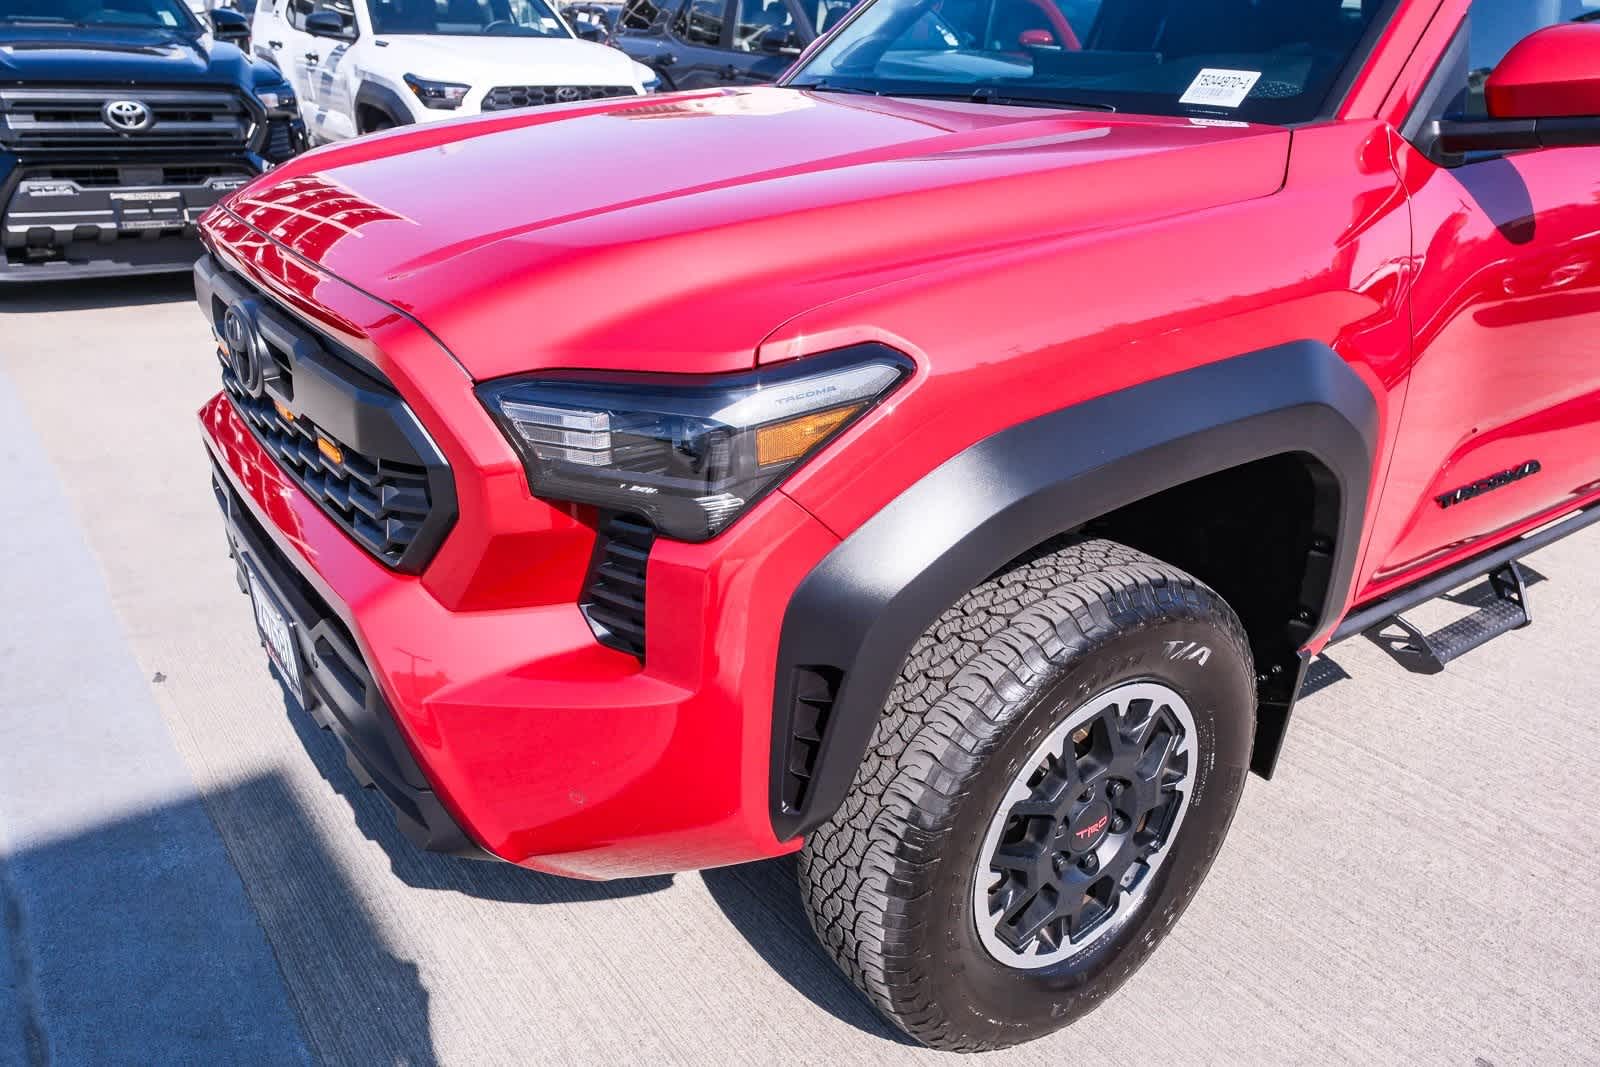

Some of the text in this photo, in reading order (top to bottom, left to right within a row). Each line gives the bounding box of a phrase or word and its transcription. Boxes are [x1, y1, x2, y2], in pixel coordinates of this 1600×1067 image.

[775, 386, 836, 404] TACOMA
[1162, 640, 1212, 666] T/A
[1075, 815, 1108, 839] TRD
